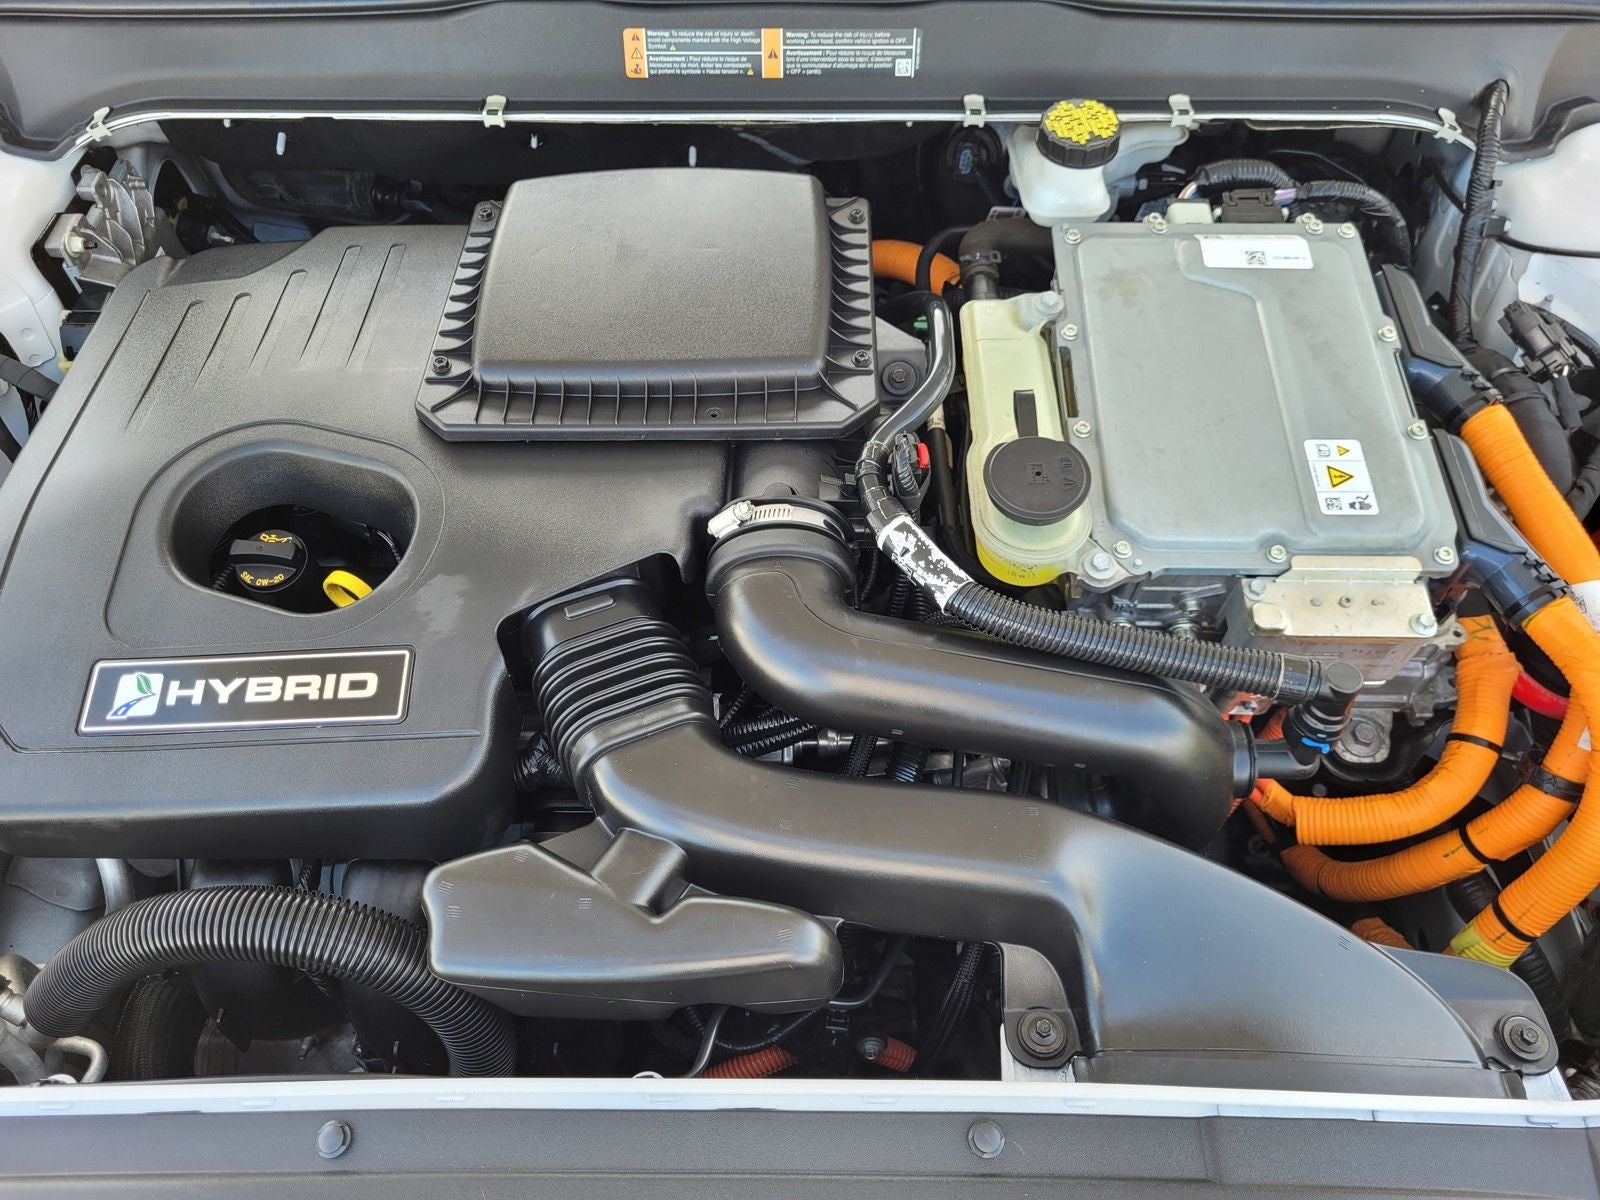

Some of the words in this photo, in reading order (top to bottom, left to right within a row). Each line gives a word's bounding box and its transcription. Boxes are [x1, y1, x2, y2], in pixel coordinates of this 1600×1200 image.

[240, 570, 255, 584] SAE
[256, 573, 284, 586] 0W-20
[166, 672, 378, 706] HYBRID
